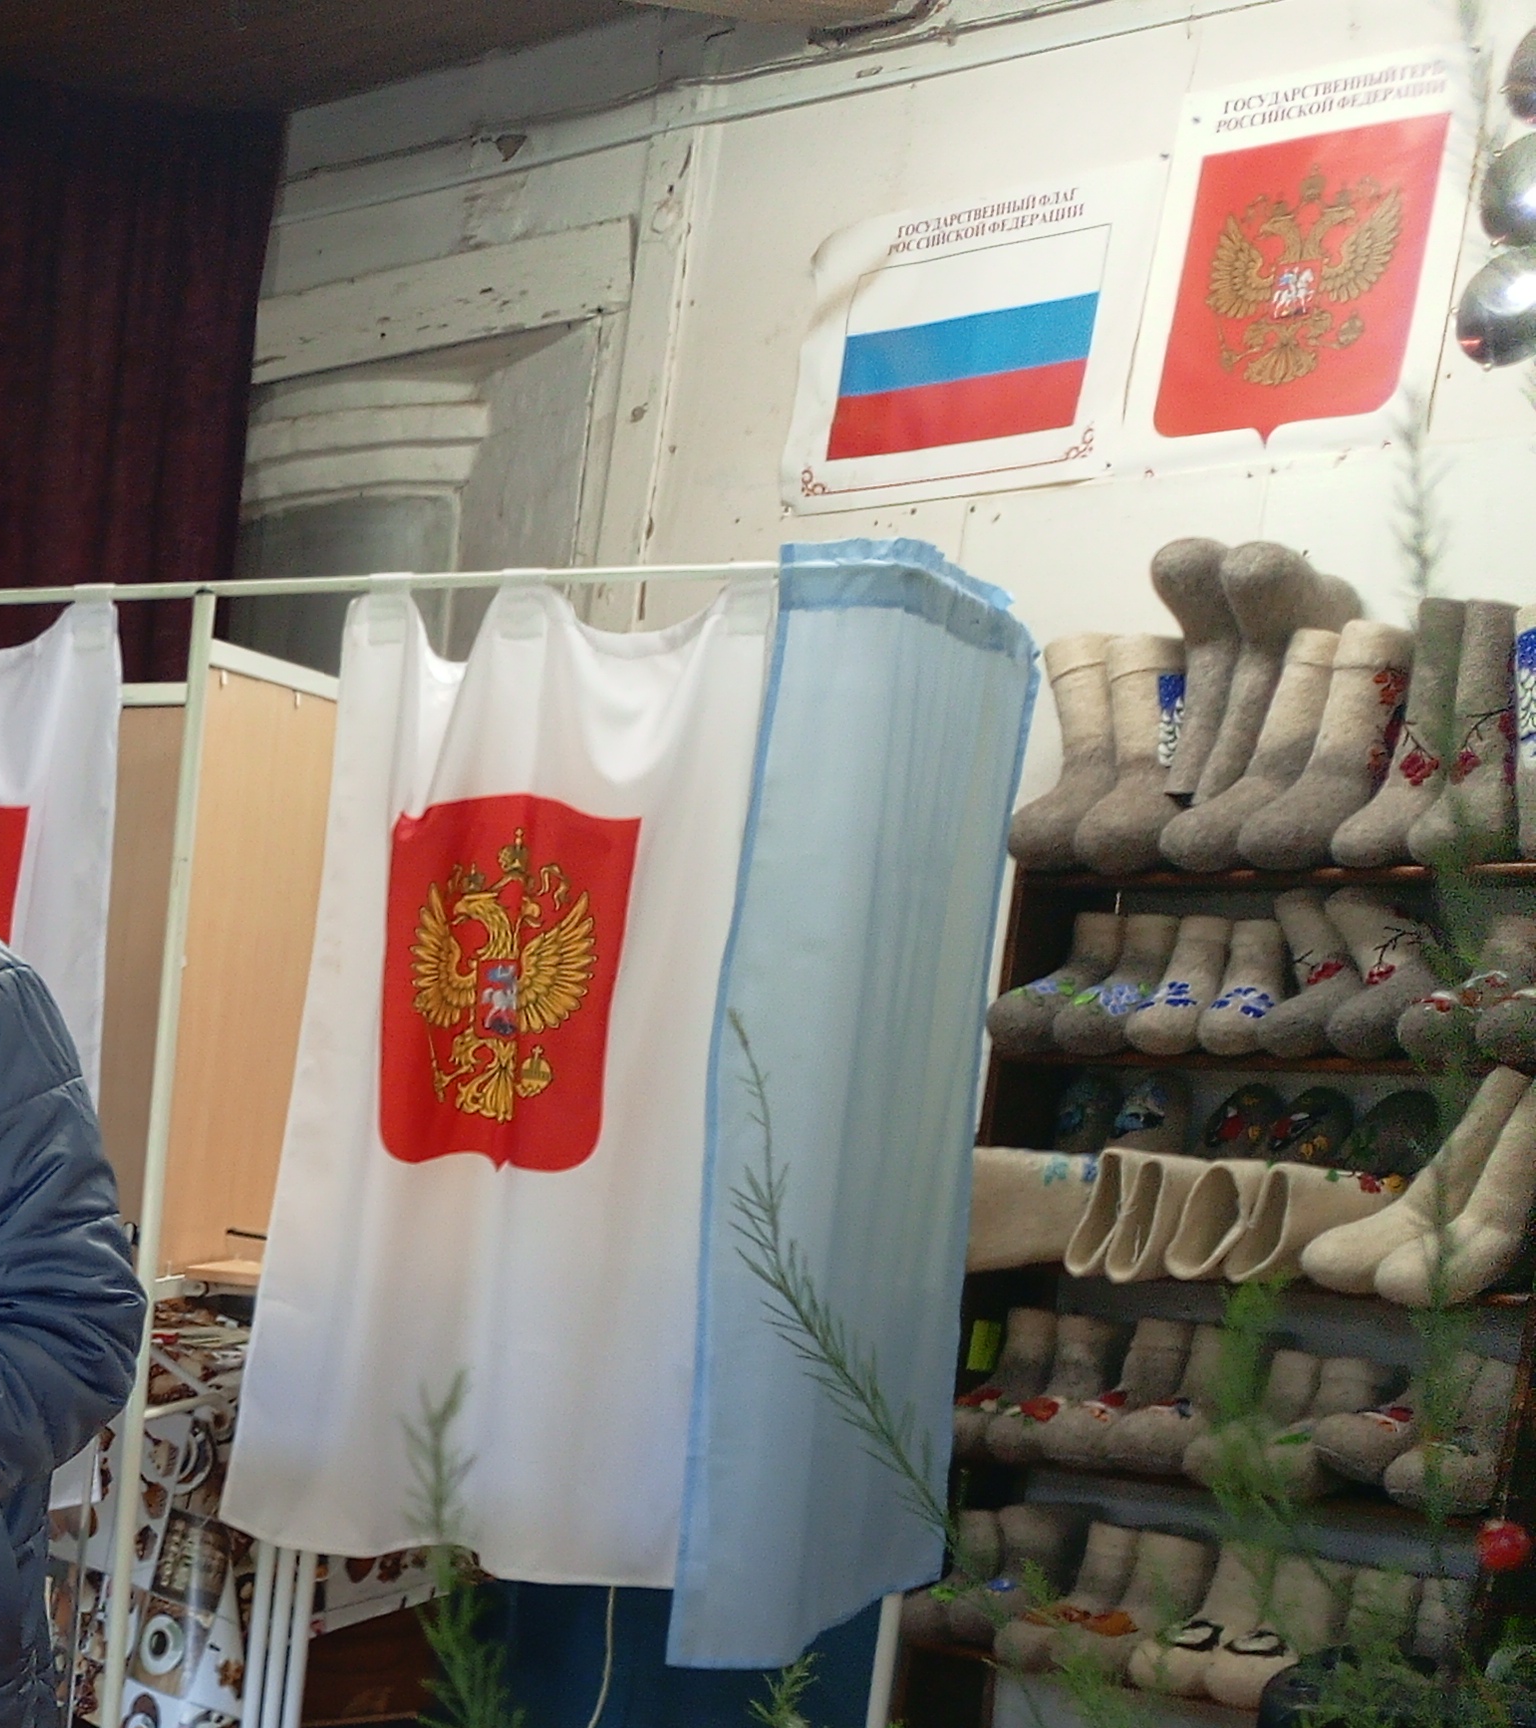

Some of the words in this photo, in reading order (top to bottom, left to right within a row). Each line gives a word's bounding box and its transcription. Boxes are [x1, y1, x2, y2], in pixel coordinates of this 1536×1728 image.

[1215, 97, 1335, 133] РОССИЙСКОЙ
[1223, 65, 1397, 115] ГОСУДАРСТВЕННЫЙ
[887, 221, 986, 256] РОССИЙСКОЙ
[988, 203, 1085, 234] ФЕДЕРАЦИИ
[897, 194, 1036, 239] ГОСУДАРСТВЕННЫЙ
[1038, 187, 1079, 207] ФЛАГ
